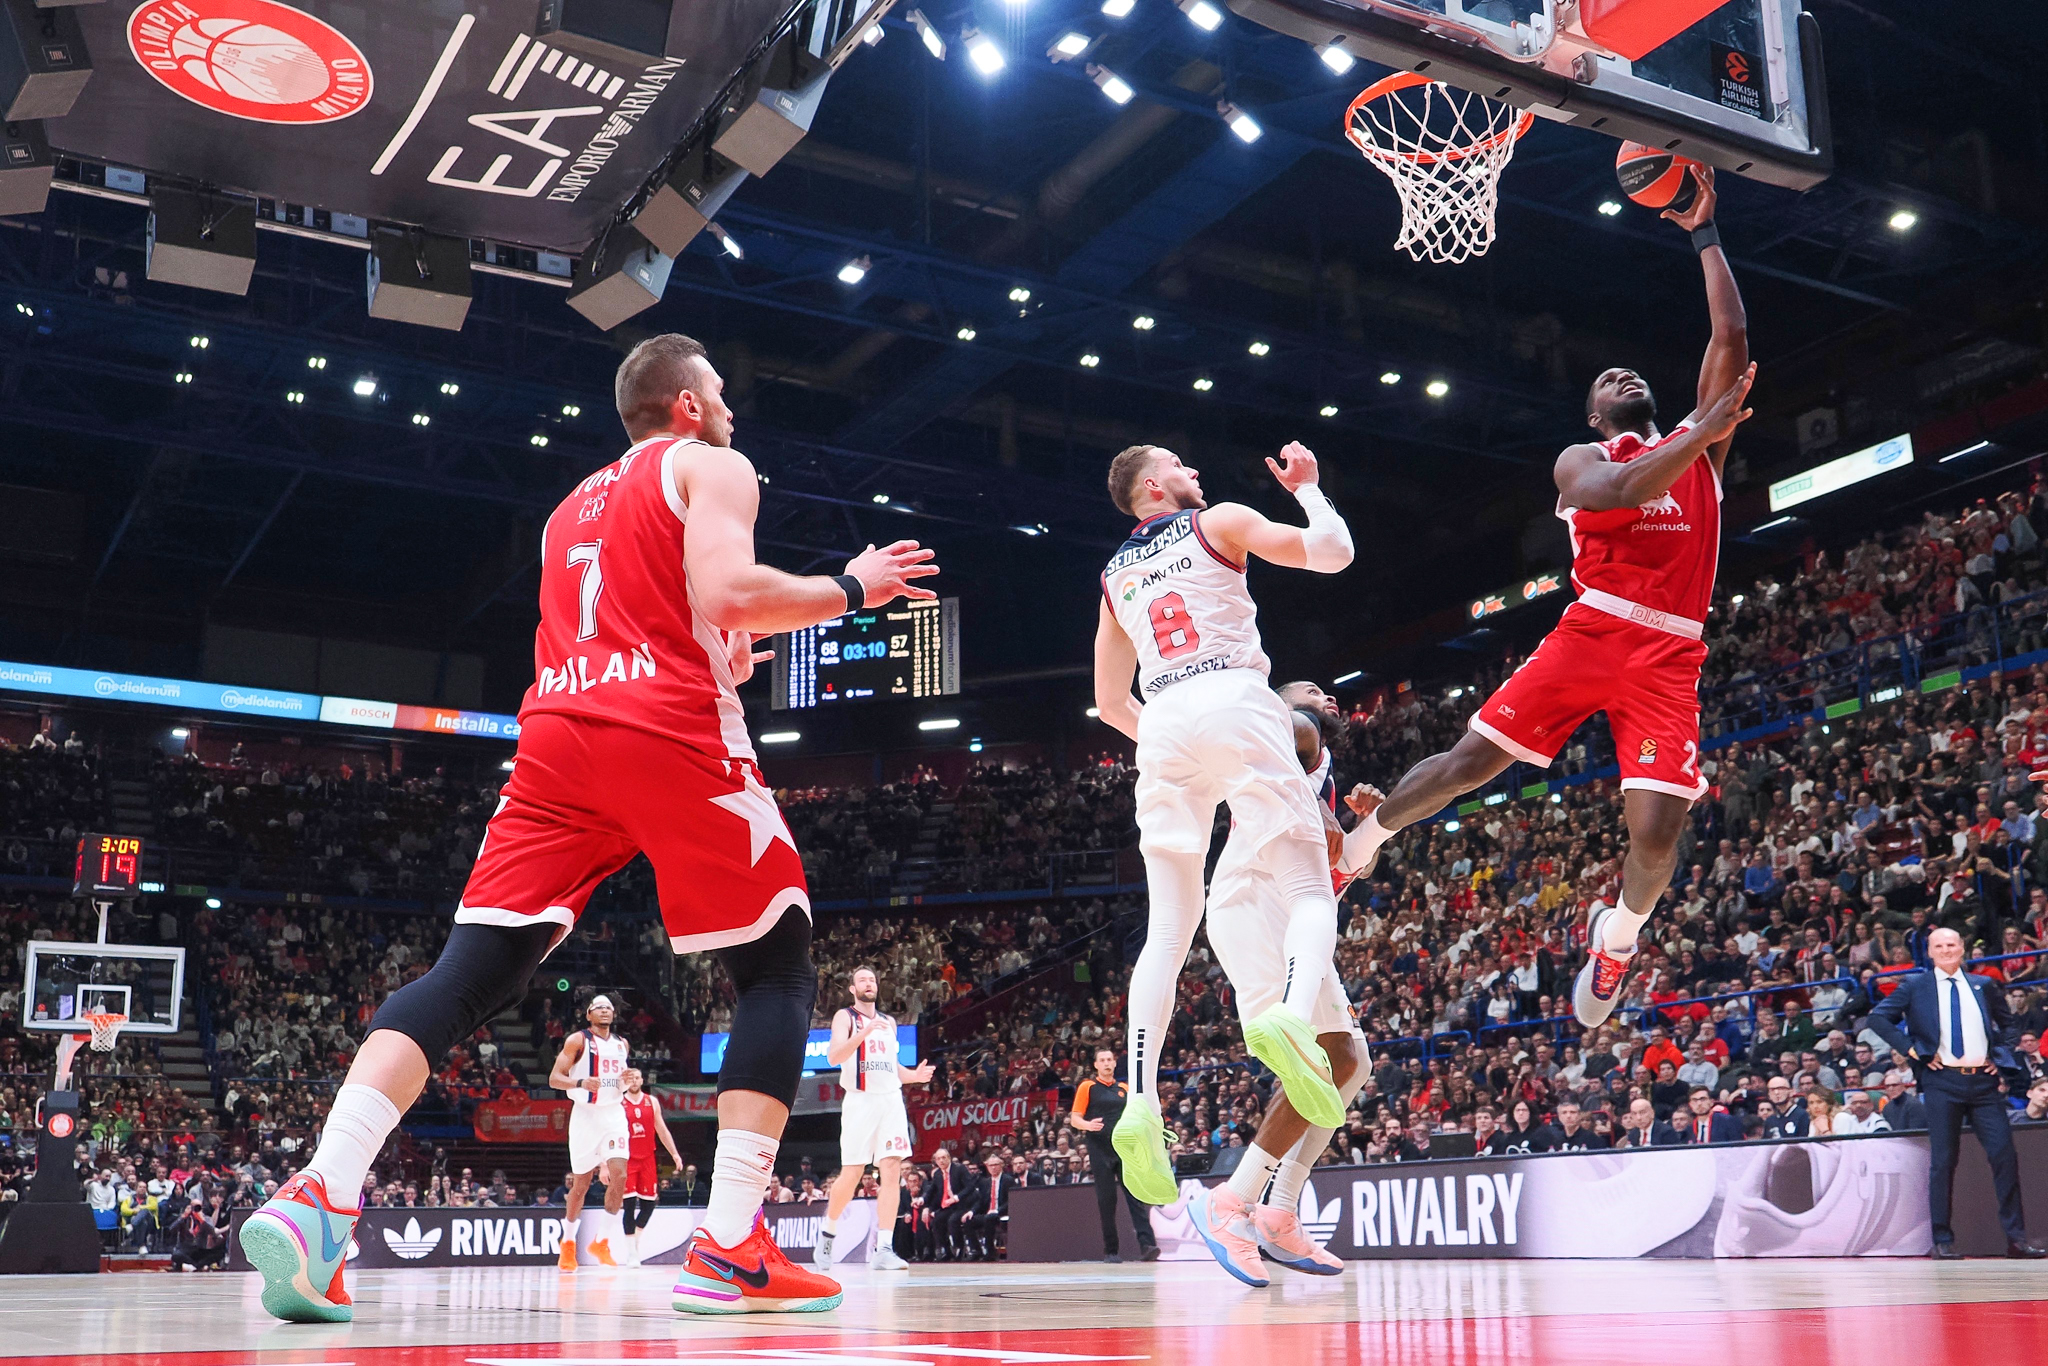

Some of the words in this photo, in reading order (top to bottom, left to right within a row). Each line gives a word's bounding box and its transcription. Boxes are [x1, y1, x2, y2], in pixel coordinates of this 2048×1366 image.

[139, 1, 200, 70] OLIMPIA
[310, 58, 364, 117] MILANO
[1720, 78, 1759, 99] TURKISH
[1721, 88, 1760, 108] AIRLINES
[546, 139, 619, 203] EMPORIO
[618, 56, 687, 122] ARMANI
[1631, 521, 1692, 533] plenitude
[566, 538, 604, 642] 7
[1147, 590, 1200, 661] 8
[820, 640, 839, 656] 68
[843, 640, 886, 661] 03:10
[890, 634, 908, 650] 57
[538, 642, 656, 699] MILAN
[94, 676, 181, 698] mediolanum
[220, 689, 303, 711] mediolanum
[351, 708, 390, 720] BOSCH
[434, 712, 499, 734] Installa
[1680, 739, 1697, 778] 2
[101, 837, 139, 854] 3:09
[101, 854, 136, 885] 19
[869, 1039, 886, 1054] 24
[602, 1059, 619, 1073] 95
[634, 1107, 641, 1119] 9
[962, 1096, 1029, 1126] SCIOLTI
[1352, 1172, 1524, 1247] RIVALRY
[451, 1218, 578, 1256] RIVALR
